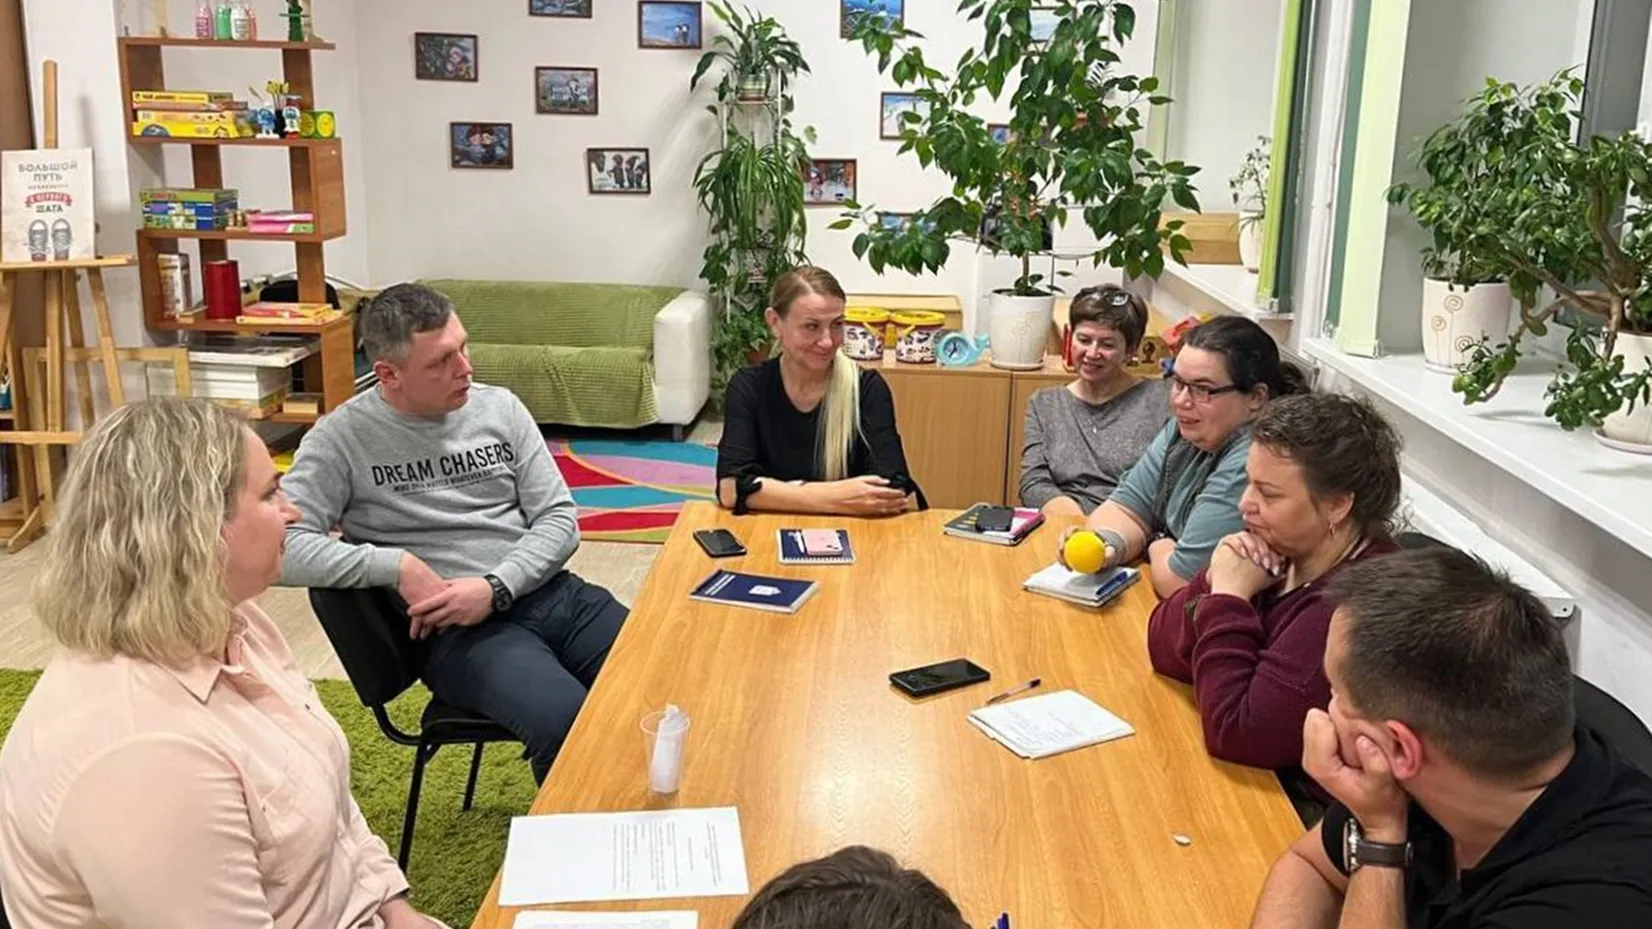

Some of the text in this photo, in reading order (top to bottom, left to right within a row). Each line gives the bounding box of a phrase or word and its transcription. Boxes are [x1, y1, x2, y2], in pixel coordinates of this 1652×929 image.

[19, 161, 77, 172] БОЛЬШОЙ
[34, 173, 62, 181] ПУТЬ
[36, 205, 63, 213] ШАГА
[372, 442, 514, 486] DREAM CHASERS
